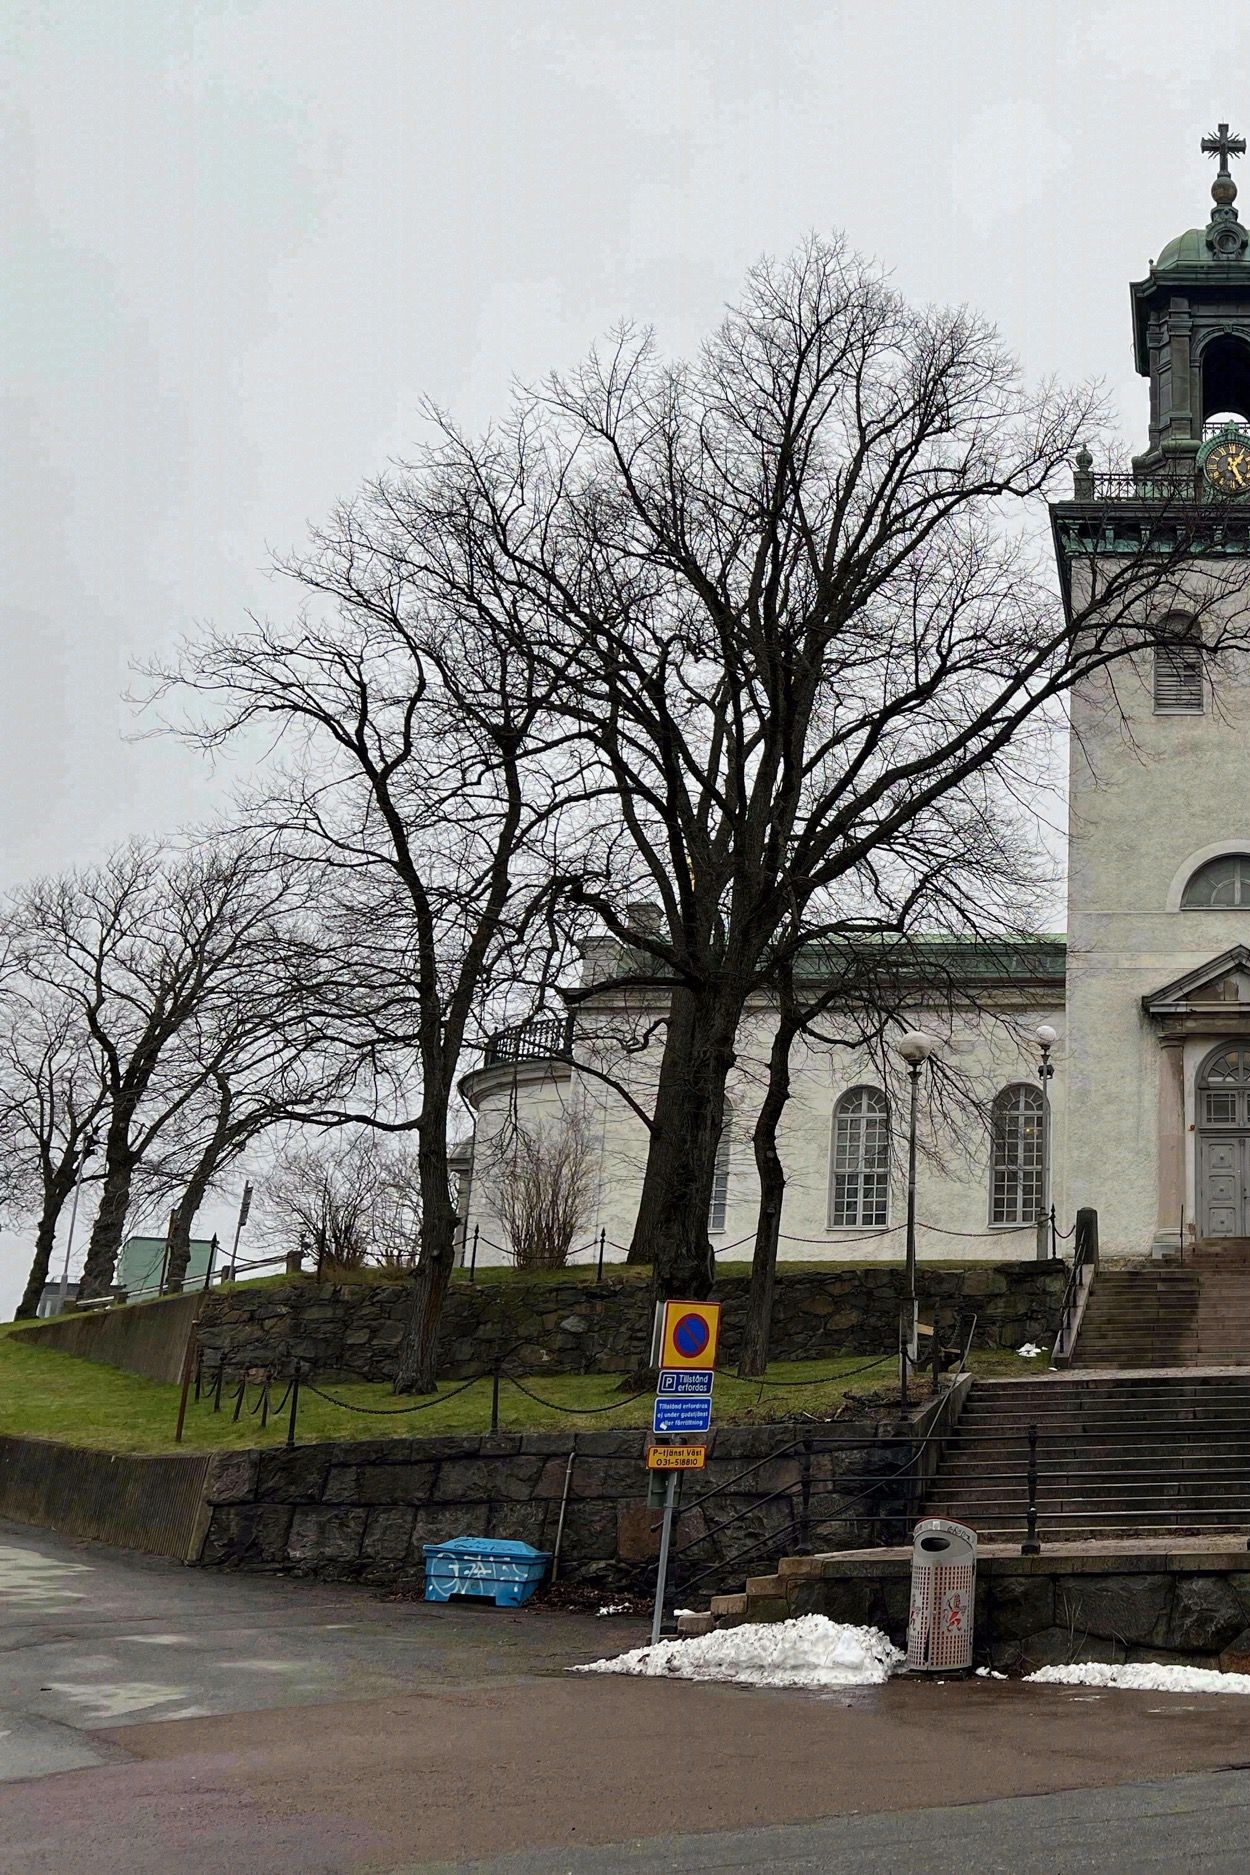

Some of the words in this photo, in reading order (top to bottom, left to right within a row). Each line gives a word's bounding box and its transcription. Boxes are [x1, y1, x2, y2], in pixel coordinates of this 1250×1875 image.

[665, 1378, 673, 1388] P
[679, 1374, 708, 1383] Tillstånd
[653, 1448, 684, 1457] P-tjänst
[686, 1448, 702, 1456] Väst
[656, 1458, 698, 1466] 031-518810
